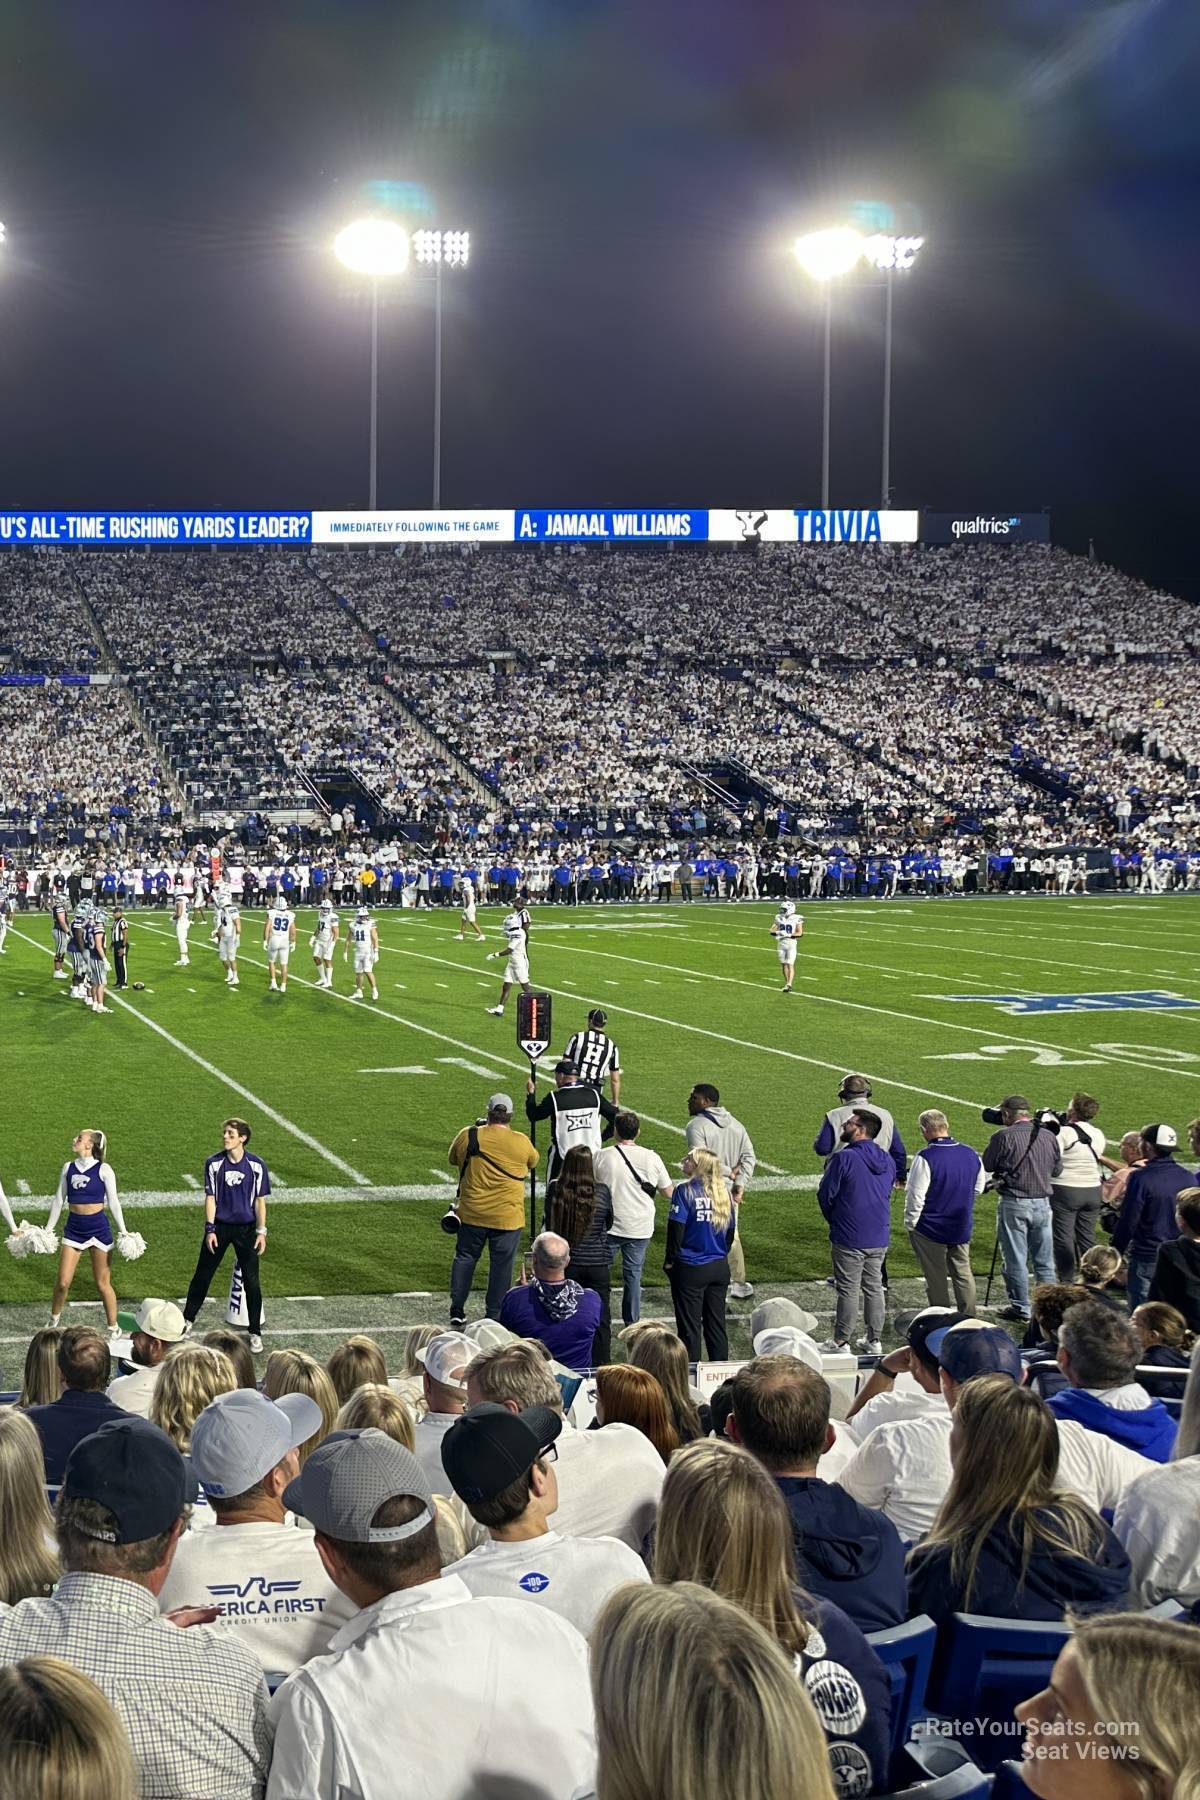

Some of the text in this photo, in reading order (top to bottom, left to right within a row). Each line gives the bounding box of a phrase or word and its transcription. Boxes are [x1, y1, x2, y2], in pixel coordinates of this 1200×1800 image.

[30, 516, 106, 539] ALL-TIME
[110, 516, 179, 539] RUSHING
[182, 516, 236, 539] YARDS
[239, 516, 309, 539] LEADER?
[330, 521, 500, 533] IMMEDIATELY FOLLOWING THE GAME
[519, 513, 691, 538] A: JAMAAL WILLIAMS
[793, 510, 883, 542] TRIVIA
[951, 516, 1009, 539] qualtrics
[273, 917, 290, 932] 93
[355, 930, 366, 942] 11
[583, 1042, 605, 1066] H
[706, 1372, 737, 1382] ENTE
[274, 1598, 326, 1615] FIRST
[220, 1616, 299, 1627] CREDIT UNION
